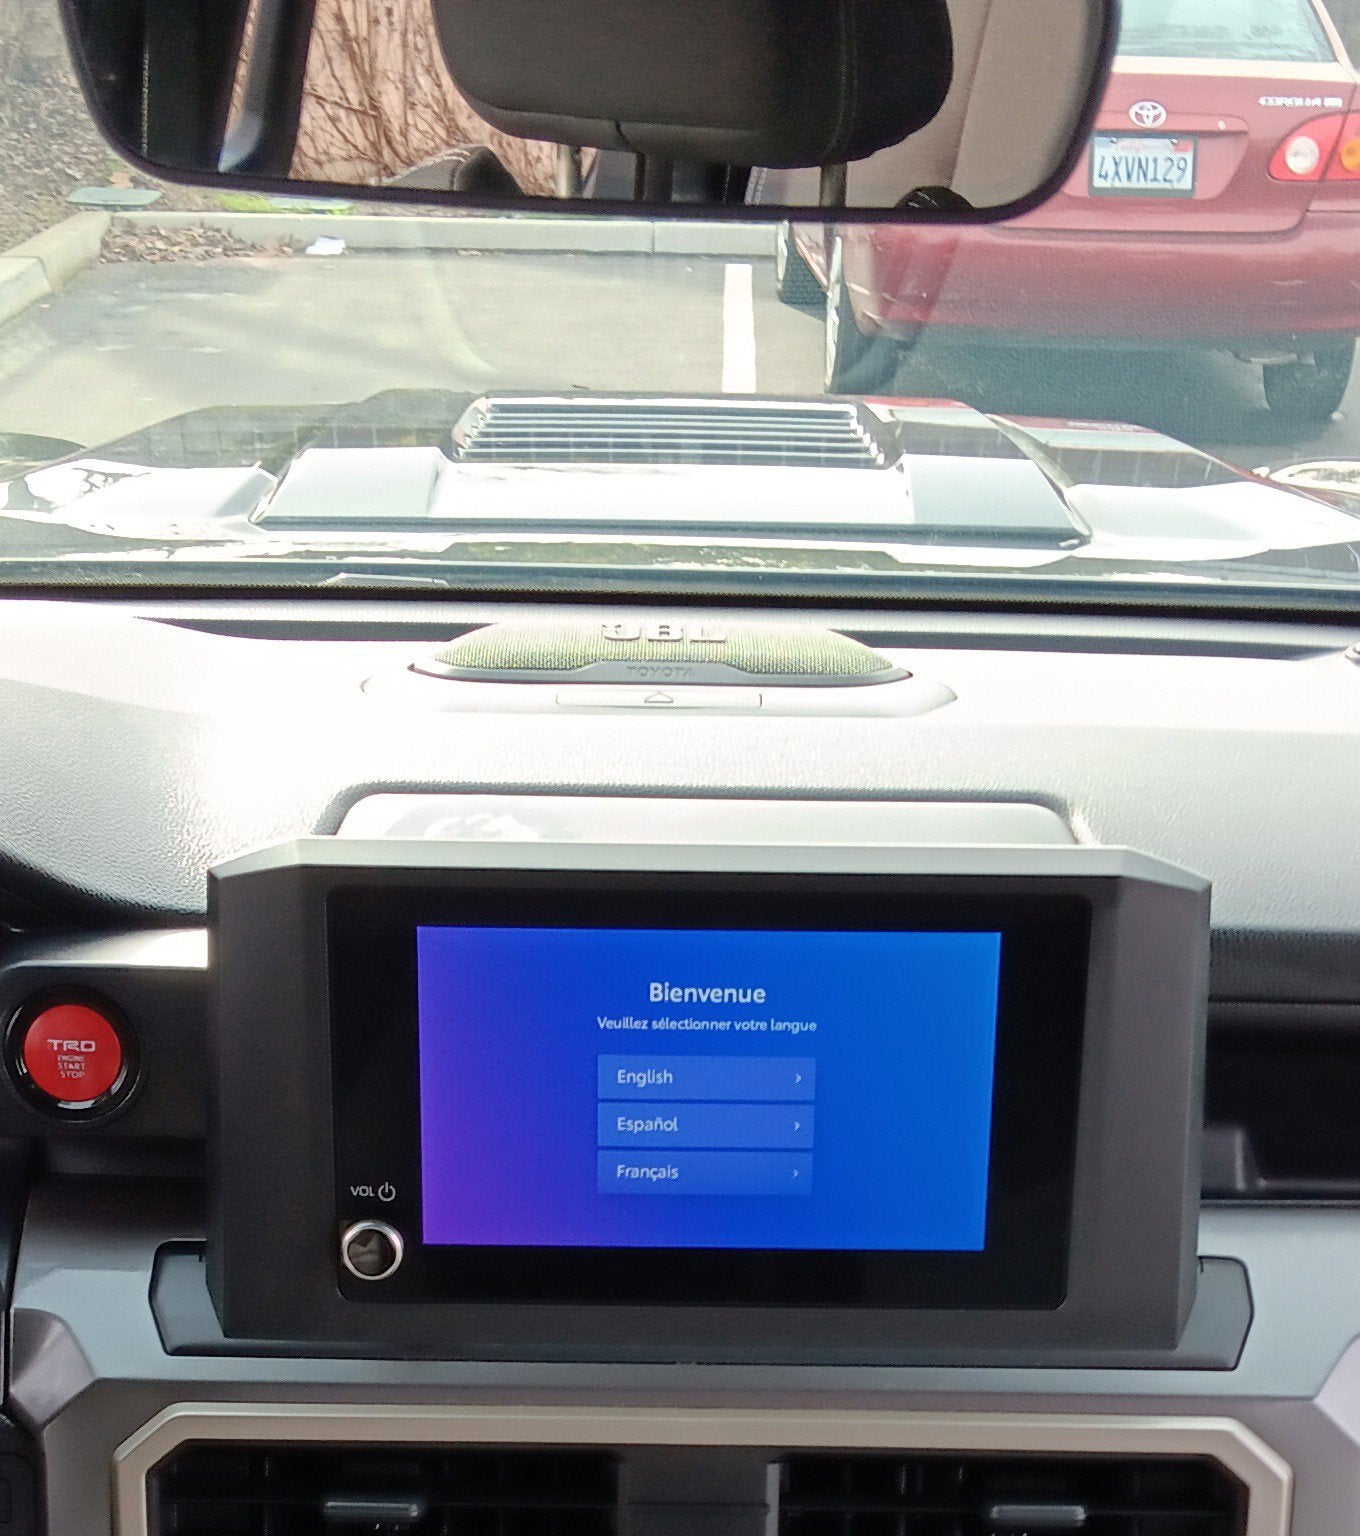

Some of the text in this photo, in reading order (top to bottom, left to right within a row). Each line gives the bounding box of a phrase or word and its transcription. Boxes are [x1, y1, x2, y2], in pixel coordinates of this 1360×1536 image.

[1098, 155, 1188, 183] 4XVN129
[626, 666, 695, 677] TOYOTA
[649, 981, 767, 1004] Bienvenue
[597, 1016, 818, 1035] Veuillez sélectionner votre langue
[47, 1039, 96, 1052] TRD
[57, 1062, 87, 1071] START
[60, 1070, 86, 1079] STOP
[617, 1069, 674, 1088] English
[616, 1117, 679, 1134] Español
[616, 1164, 679, 1183] Français
[350, 1185, 376, 1197] VOL
